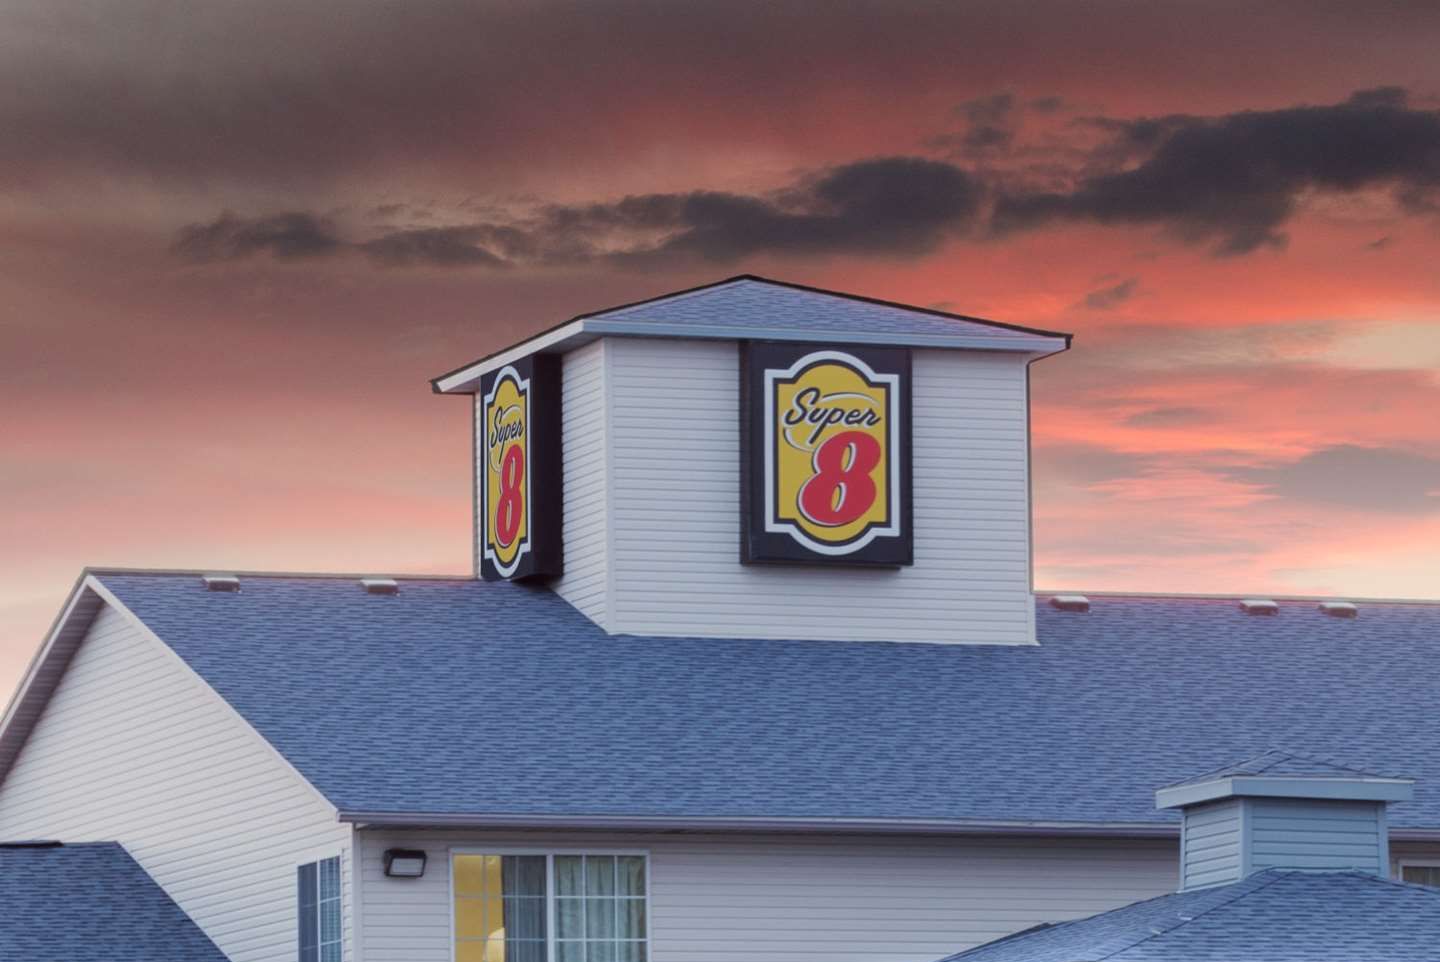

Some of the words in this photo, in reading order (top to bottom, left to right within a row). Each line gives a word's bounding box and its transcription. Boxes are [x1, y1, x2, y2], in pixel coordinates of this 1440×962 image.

[490, 405, 524, 465] Super
[783, 386, 881, 445] Super
[495, 443, 524, 548] 8
[797, 430, 882, 528] 8
